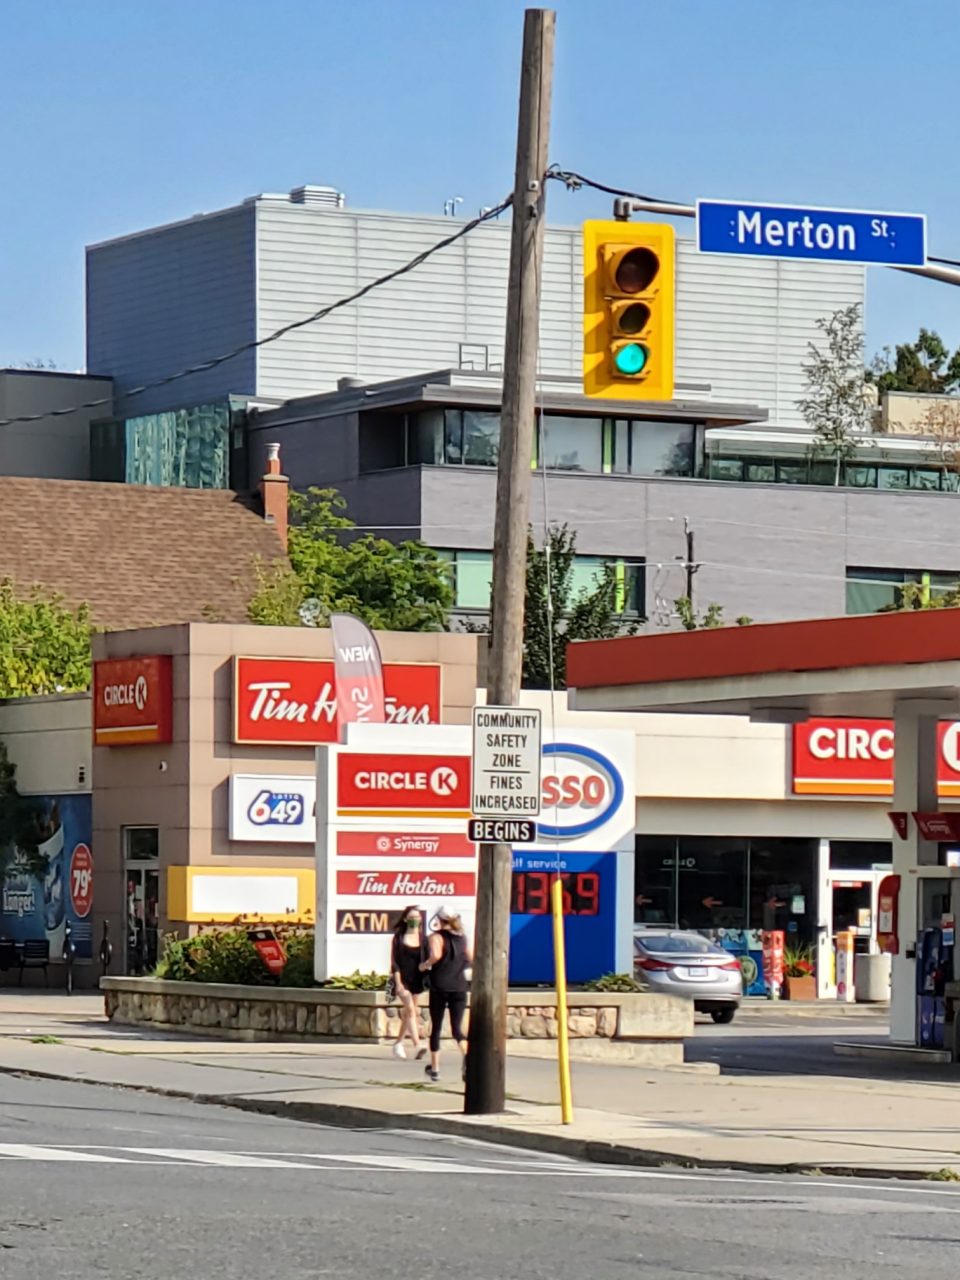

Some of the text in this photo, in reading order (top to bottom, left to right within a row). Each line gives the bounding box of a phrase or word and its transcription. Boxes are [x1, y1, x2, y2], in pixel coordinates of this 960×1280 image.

[737, 210, 856, 251] Merton
[104, 676, 148, 710] CIRCLE K
[247, 682, 308, 722] Tim
[476, 712, 537, 729] COMMUNITY
[486, 733, 527, 749] SAFETY
[808, 727, 894, 760] CIRC
[492, 753, 521, 768] ZONE
[354, 766, 458, 796] CIRCLE K
[489, 775, 523, 790] FINES
[475, 794, 537, 811] INCREASED
[473, 821, 530, 841] BEGINS
[393, 837, 440, 852] Synergy
[527, 859, 567, 869] service
[357, 872, 455, 895] Tim Hortons
[339, 912, 389, 932] ATM
